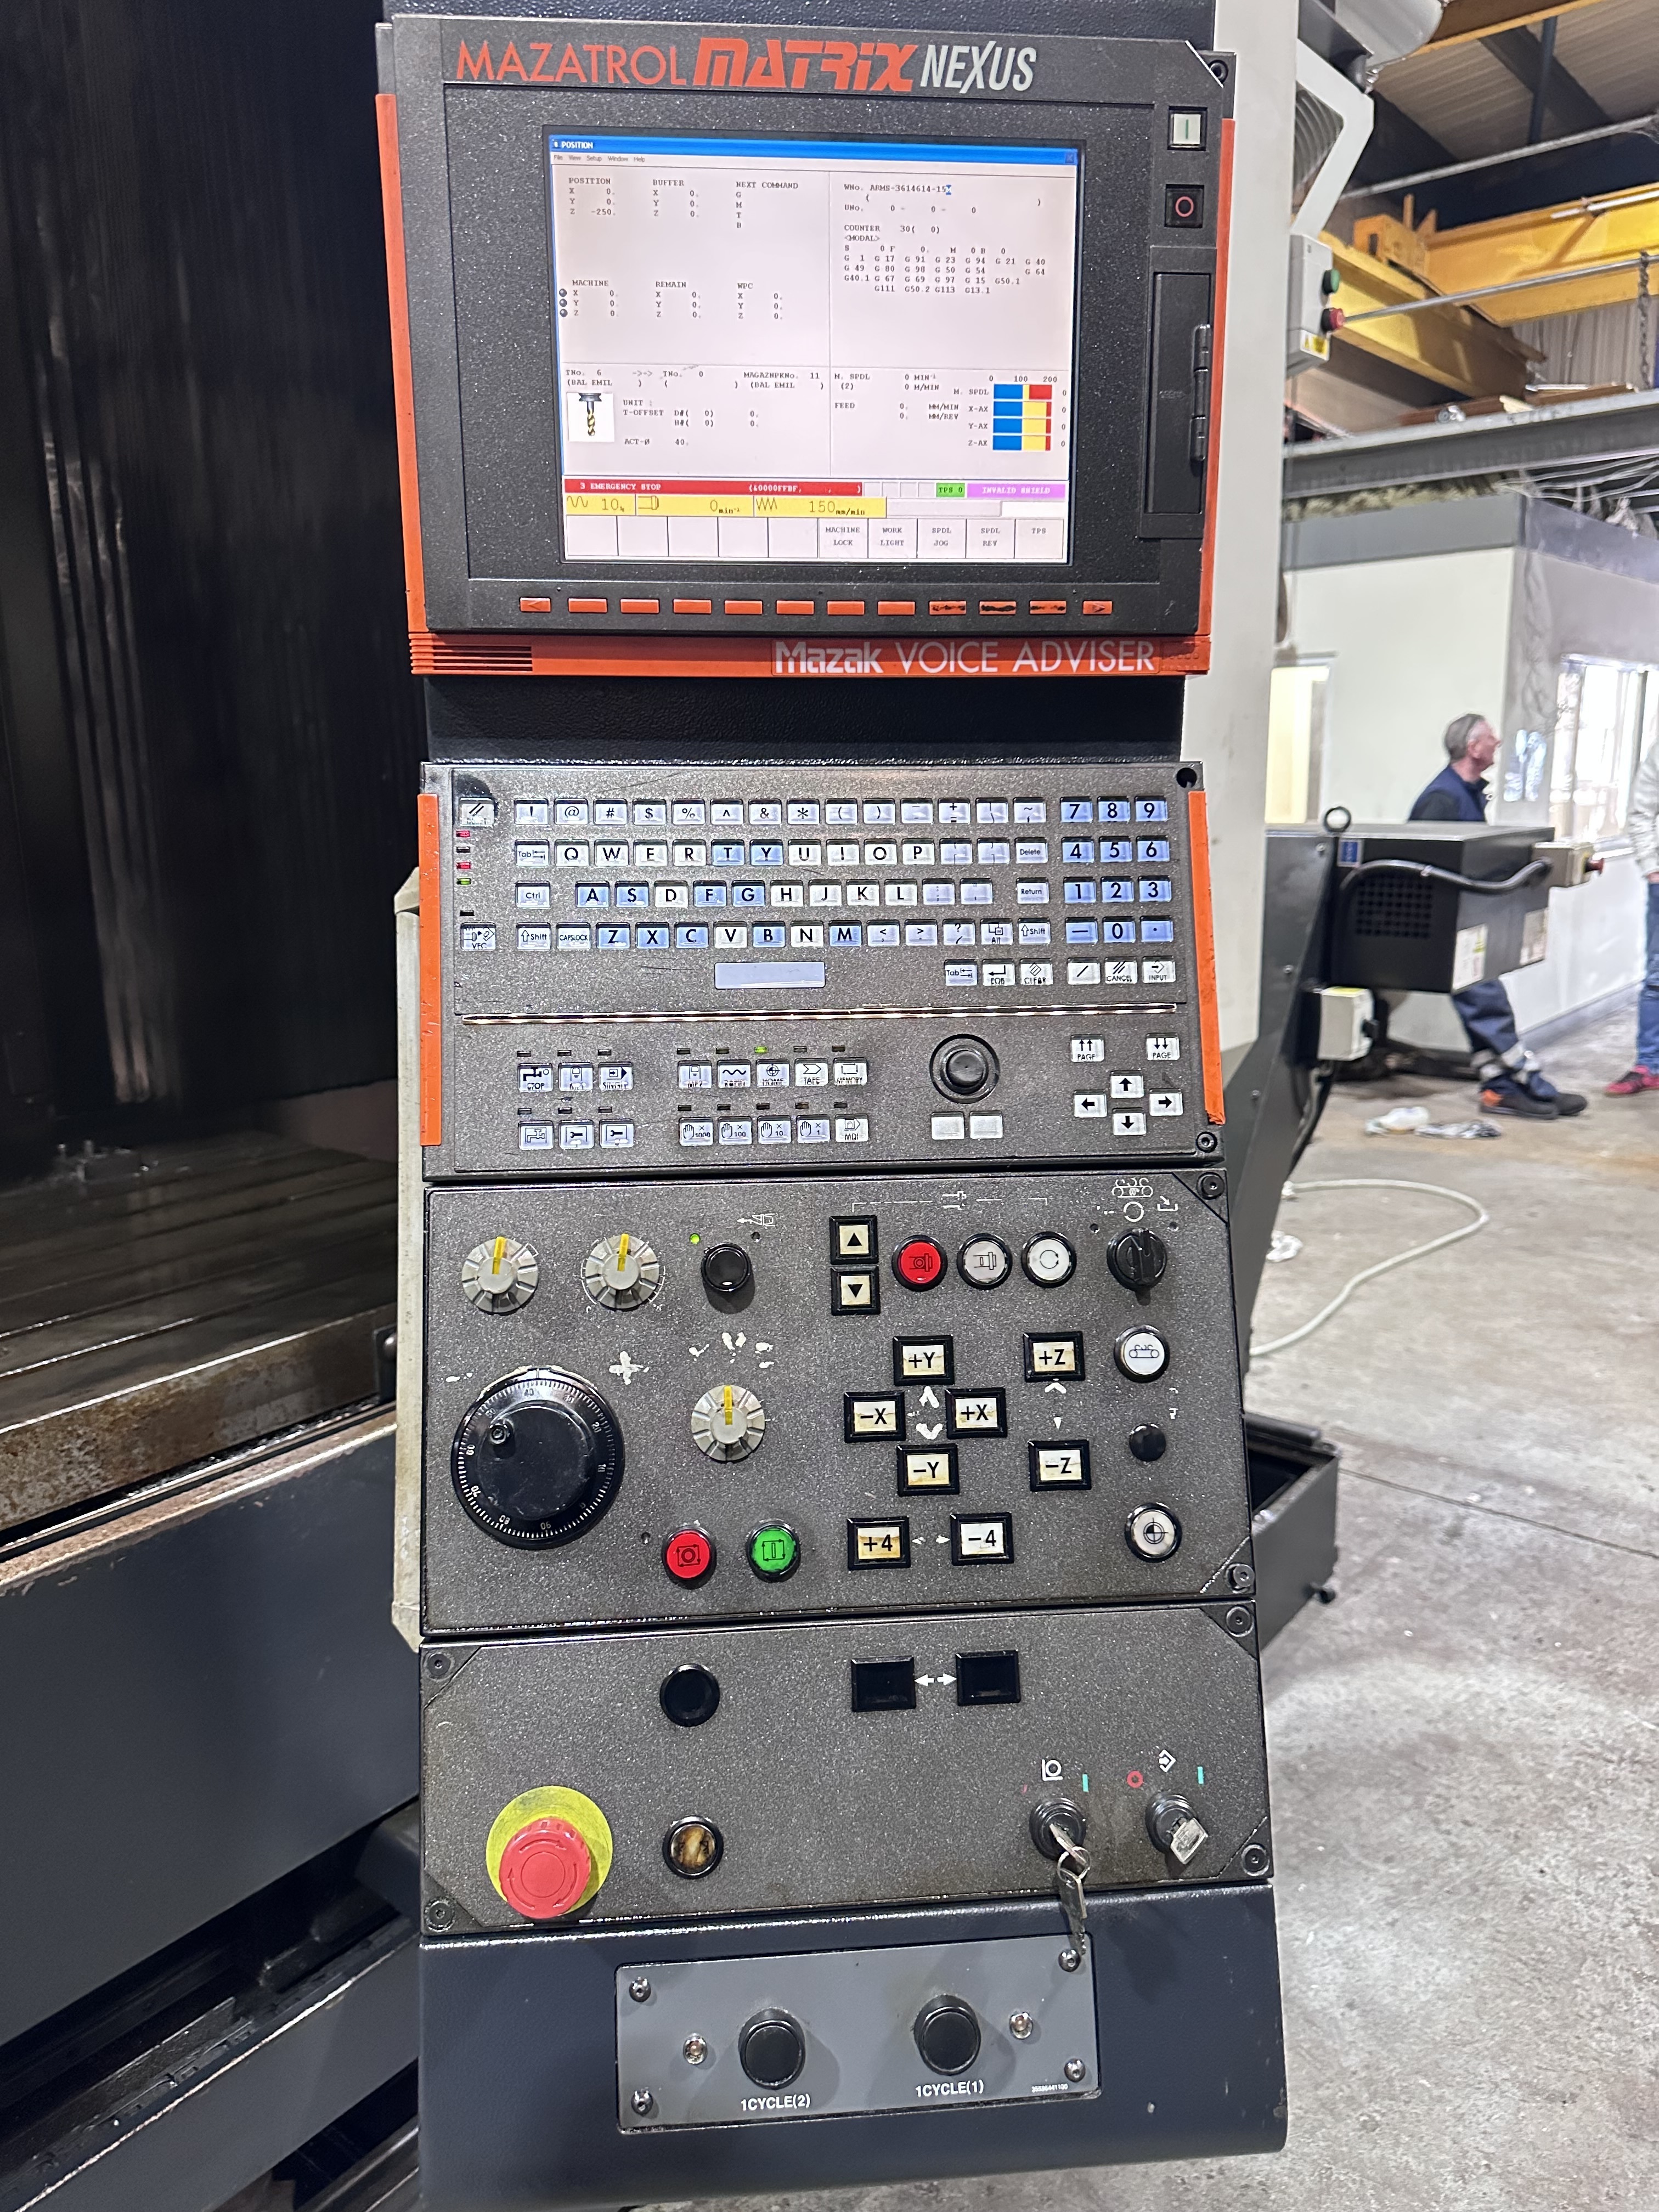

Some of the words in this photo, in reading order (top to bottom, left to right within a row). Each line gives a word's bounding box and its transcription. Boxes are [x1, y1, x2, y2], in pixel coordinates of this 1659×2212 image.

[456, 42, 686, 86] MAZATROL
[921, 41, 1036, 93] NEXUS
[561, 141, 594, 150] POSITION
[568, 177, 611, 185] POSITION
[652, 178, 684, 187] BUFFER
[623, 399, 644, 407] UNIT
[928, 403, 959, 411] MM/MIN
[928, 413, 959, 421] MM/REV
[774, 643, 883, 674] Mazak
[896, 641, 997, 672] VOICE
[1012, 641, 1155, 672] ADVISER
[1069, 804, 1080, 819] 7
[1107, 803, 1118, 819] 8
[1144, 803, 1154, 819] 9
[564, 848, 579, 861] Q
[602, 847, 621, 861] W
[685, 848, 694, 861] R
[724, 847, 732, 861] T
[761, 847, 772, 861] Y
[799, 847, 809, 861] U
[873, 847, 887, 860] O
[913, 846, 922, 860] P
[1070, 844, 1081, 859] 4
[1110, 843, 1119, 858] 5
[1146, 842, 1157, 857] 6
[586, 889, 599, 902] A
[628, 888, 637, 902] S
[665, 889, 676, 902] D
[706, 889, 713, 901] F
[741, 888, 754, 901] G
[781, 888, 792, 901] H
[821, 887, 828, 901] J
[857, 887, 867, 900] K
[897, 887, 904, 900] L
[1076, 884, 1081, 899] 1
[1110, 883, 1121, 898] 2
[1148, 882, 1158, 898] 3
[608, 930, 619, 944] Z
[647, 930, 658, 944] X
[686, 929, 697, 943] C
[725, 928, 736, 943] V
[764, 928, 772, 943] B
[800, 928, 812, 942] N
[837, 927, 852, 942] M
[1112, 923, 1123, 939] 0
[907, 1351, 935, 1369] +Y
[1039, 1348, 1065, 1366] +Z
[860, 1408, 887, 1425] -X
[961, 1404, 988, 1421] +X
[592, 1421, 602, 1433] 20
[912, 1462, 939, 1479] -Y
[1045, 1458, 1071, 1474] -Z
[471, 1485, 481, 1498] 70
[499, 1515, 511, 1525] 80
[540, 1522, 551, 1530] 90
[863, 1534, 894, 1552] +4
[968, 1530, 997, 1548] -4
[916, 2080, 984, 2098] 1CYCLE(1)
[740, 2094, 811, 2112] 1CYCLE(2)
